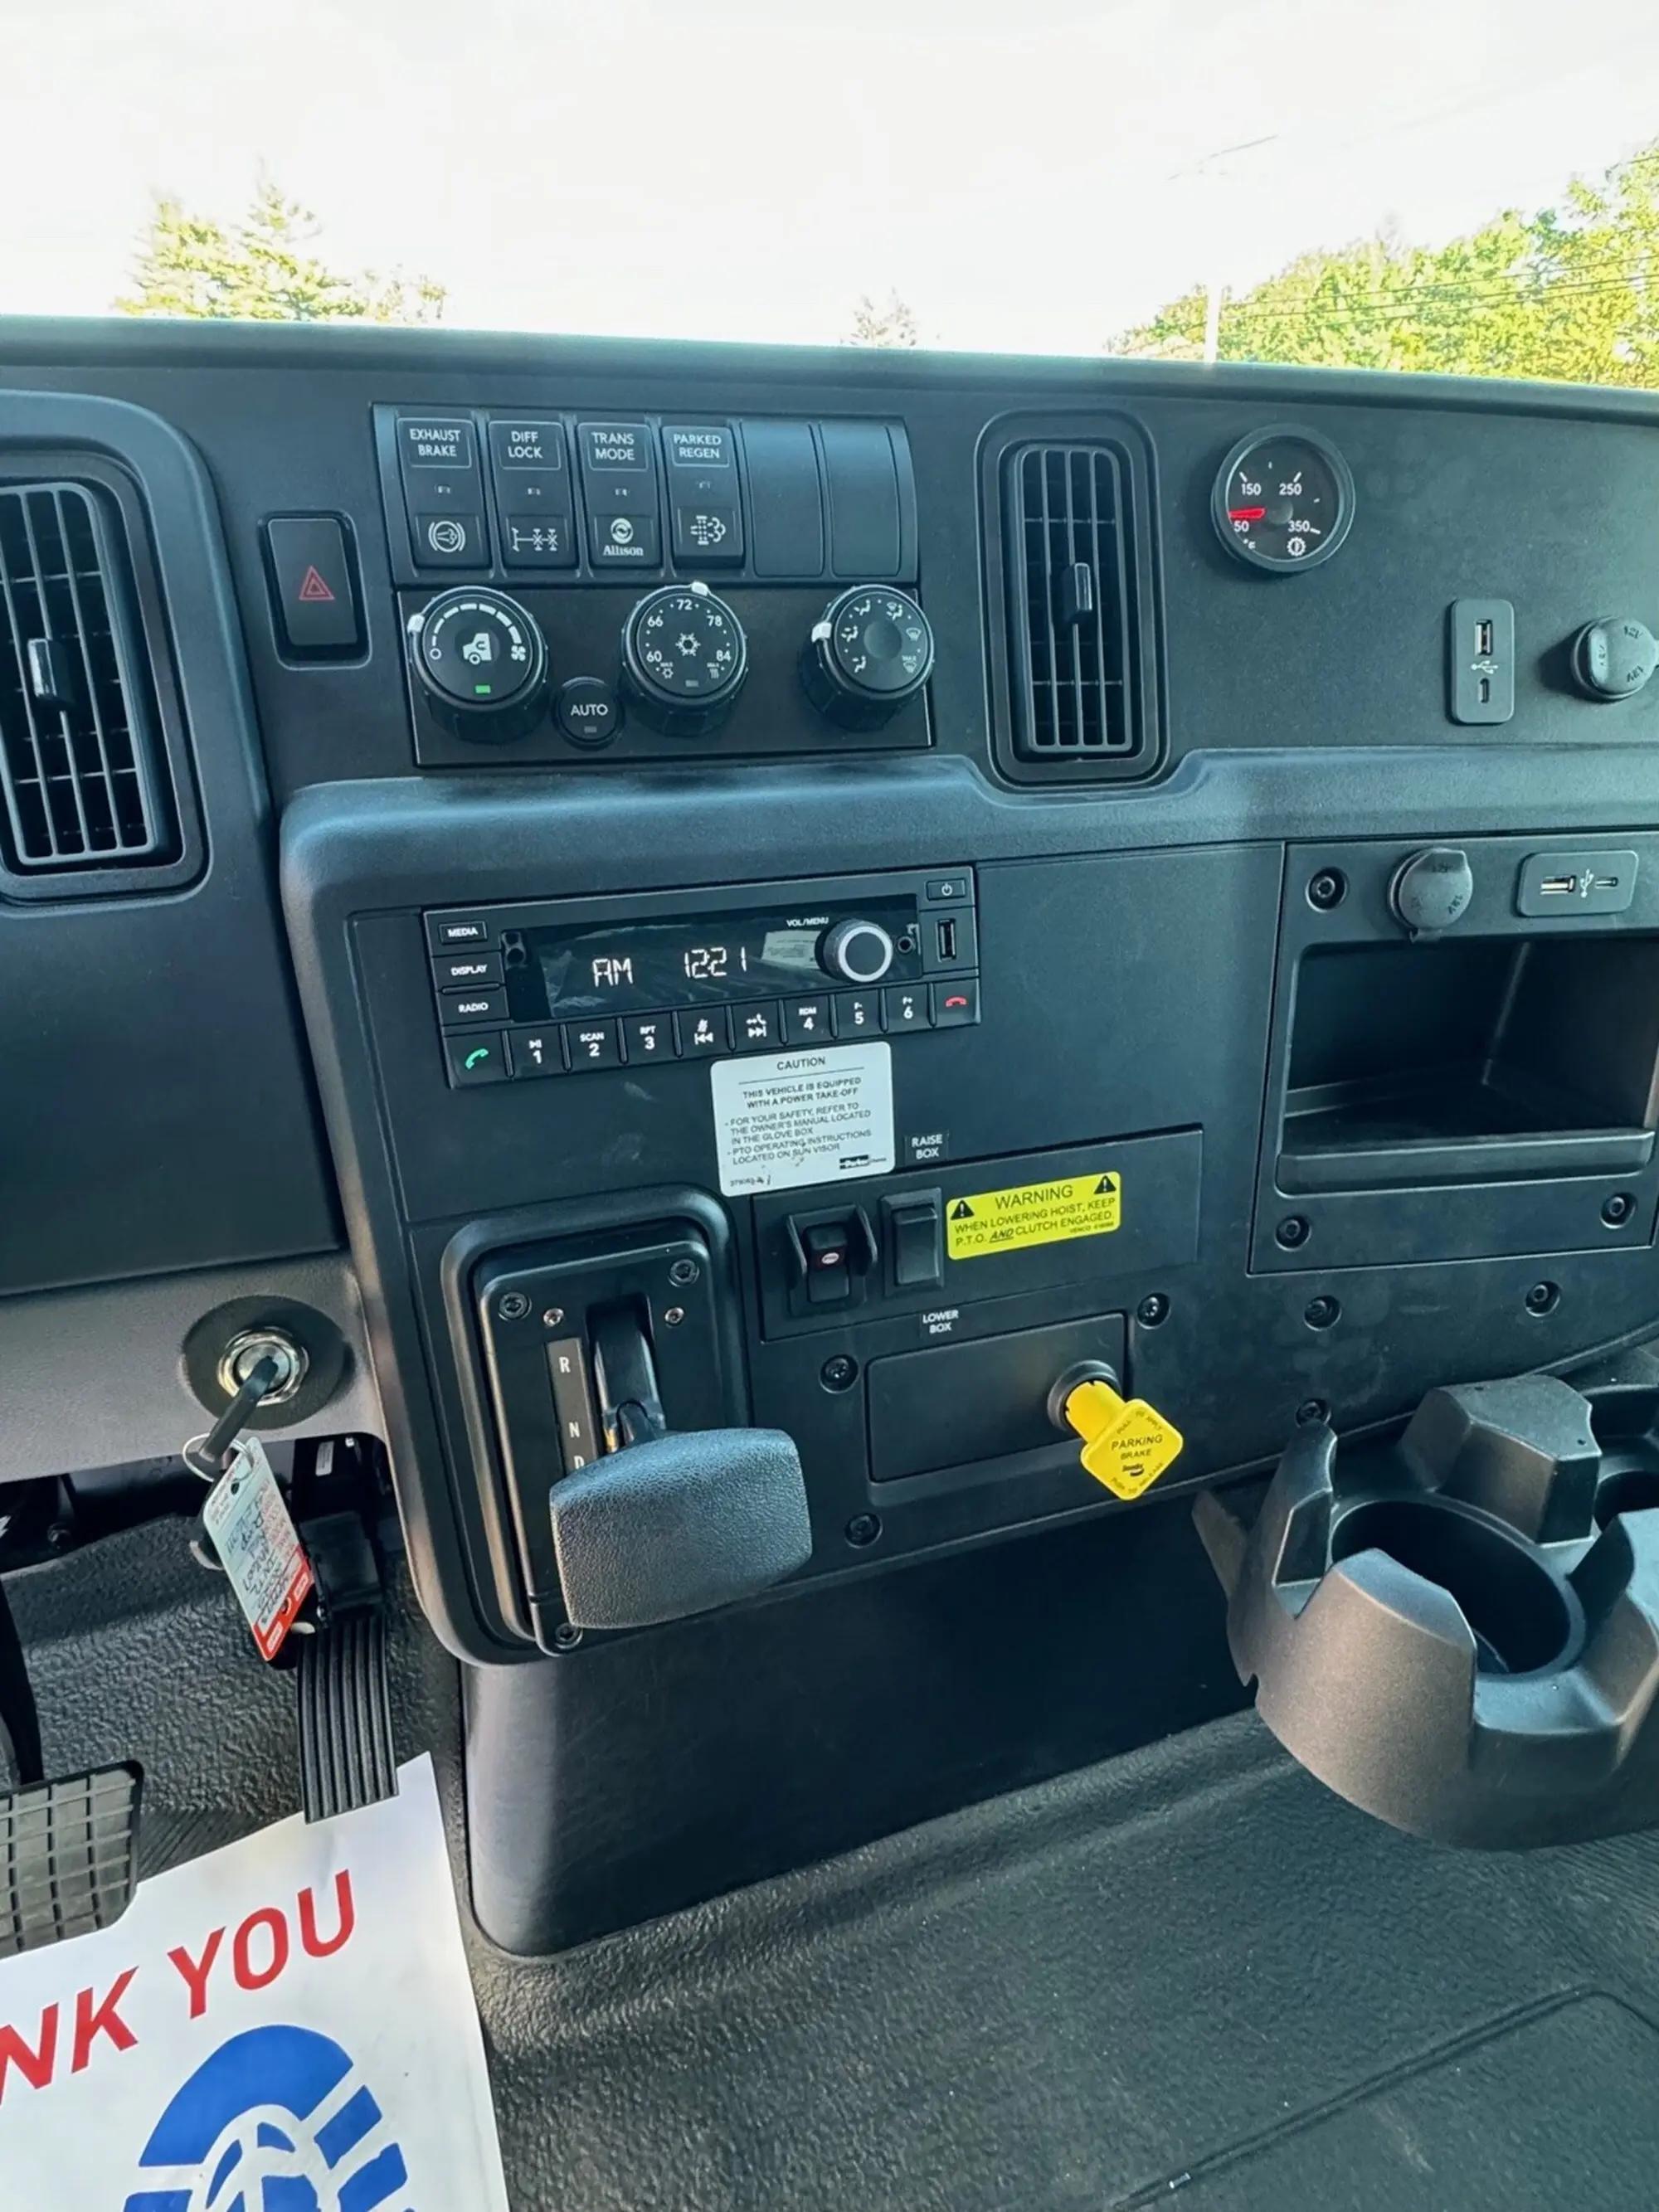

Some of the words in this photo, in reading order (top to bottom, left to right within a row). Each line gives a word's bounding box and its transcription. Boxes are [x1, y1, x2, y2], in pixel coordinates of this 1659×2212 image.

[410, 428, 461, 442] EXHAUST
[511, 430, 539, 443] DIFF
[591, 432, 635, 446] TRANS
[674, 434, 722, 446] PARKED
[417, 444, 458, 458] BRAKE
[508, 445, 543, 459] LOCK
[596, 448, 635, 461] MODE
[679, 447, 721, 459] REGEN
[1241, 484, 1262, 495] 150
[1279, 484, 1302, 495] 250
[1233, 520, 1250, 532] 50
[1287, 520, 1311, 532] 350
[602, 544, 644, 557] Allison
[676, 599, 693, 611] 72
[647, 615, 664, 628] 66
[707, 615, 723, 628] 78
[646, 650, 663, 663] 60
[716, 649, 732, 663] 84
[570, 703, 609, 717] AUTO
[786, 916, 830, 927] VOL/MENU
[447, 926, 479, 938] MEDIA
[450, 965, 488, 976] DISPLAY
[591, 957, 635, 988] AM
[458, 1002, 489, 1013] RADIO
[903, 1008, 913, 1019] 6
[803, 1017, 815, 1030] 4
[854, 1011, 864, 1025] 5
[580, 1032, 605, 1042] SCAN
[640, 1025, 656, 1035] RPT
[588, 1043, 601, 1057] 2
[644, 1036, 655, 1050] 3
[532, 1049, 542, 1064] 1
[776, 1056, 826, 1071] CAUTION
[743, 1090, 763, 1099] THIS
[766, 1084, 804, 1096] VEHICLE
[805, 1082, 815, 1091] IS
[817, 1077, 862, 1091] EQUIPPED
[747, 1099, 771, 1109] WITH
[781, 1093, 814, 1105] POWER
[815, 1087, 859, 1101] TAKE-OFF
[730, 1116, 750, 1126] FOR
[751, 1113, 777, 1124] YOUR
[815, 1104, 845, 1116] REFER
[847, 1101, 859, 1111] TO
[731, 1127, 749, 1136] THE
[750, 1121, 792, 1133] OWNER'S
[793, 1116, 830, 1127] MANUAL
[831, 1110, 872, 1123] LOCATED
[732, 1137, 741, 1145] IN
[742, 1134, 761, 1144] THE
[762, 1130, 793, 1141] GLOVE
[795, 1127, 814, 1136] BOX
[732, 1145, 752, 1156] PTO
[753, 1140, 807, 1153] OPERATING
[808, 1129, 873, 1145] INSTRUCTIONS
[912, 1134, 943, 1147] RAISE
[732, 1152, 776, 1165] LOCATED
[776, 1150, 791, 1159] ON
[792, 1146, 812, 1158] SUN
[813, 1143, 841, 1155] VISOR
[915, 1147, 940, 1159] BOX
[995, 1184, 1073, 1210] WARNING
[955, 1220, 988, 1234] WHEN
[990, 1210, 1048, 1228] LOWERING
[1050, 1203, 1086, 1218] HOIST,
[1087, 1197, 1116, 1211] KEEP
[990, 1228, 1014, 1242] AND
[1015, 1222, 1058, 1236] CLUTCH
[922, 1309, 960, 1324] LOWER
[929, 1321, 952, 1334] BOX
[558, 1356, 572, 1373] R
[568, 1422, 581, 1438] N
[1111, 1433, 1164, 1451] PARKING
[1120, 1448, 1152, 1461] BRAKE
[574, 1455, 586, 1470] D
[167, 1869, 356, 2020] YOU
